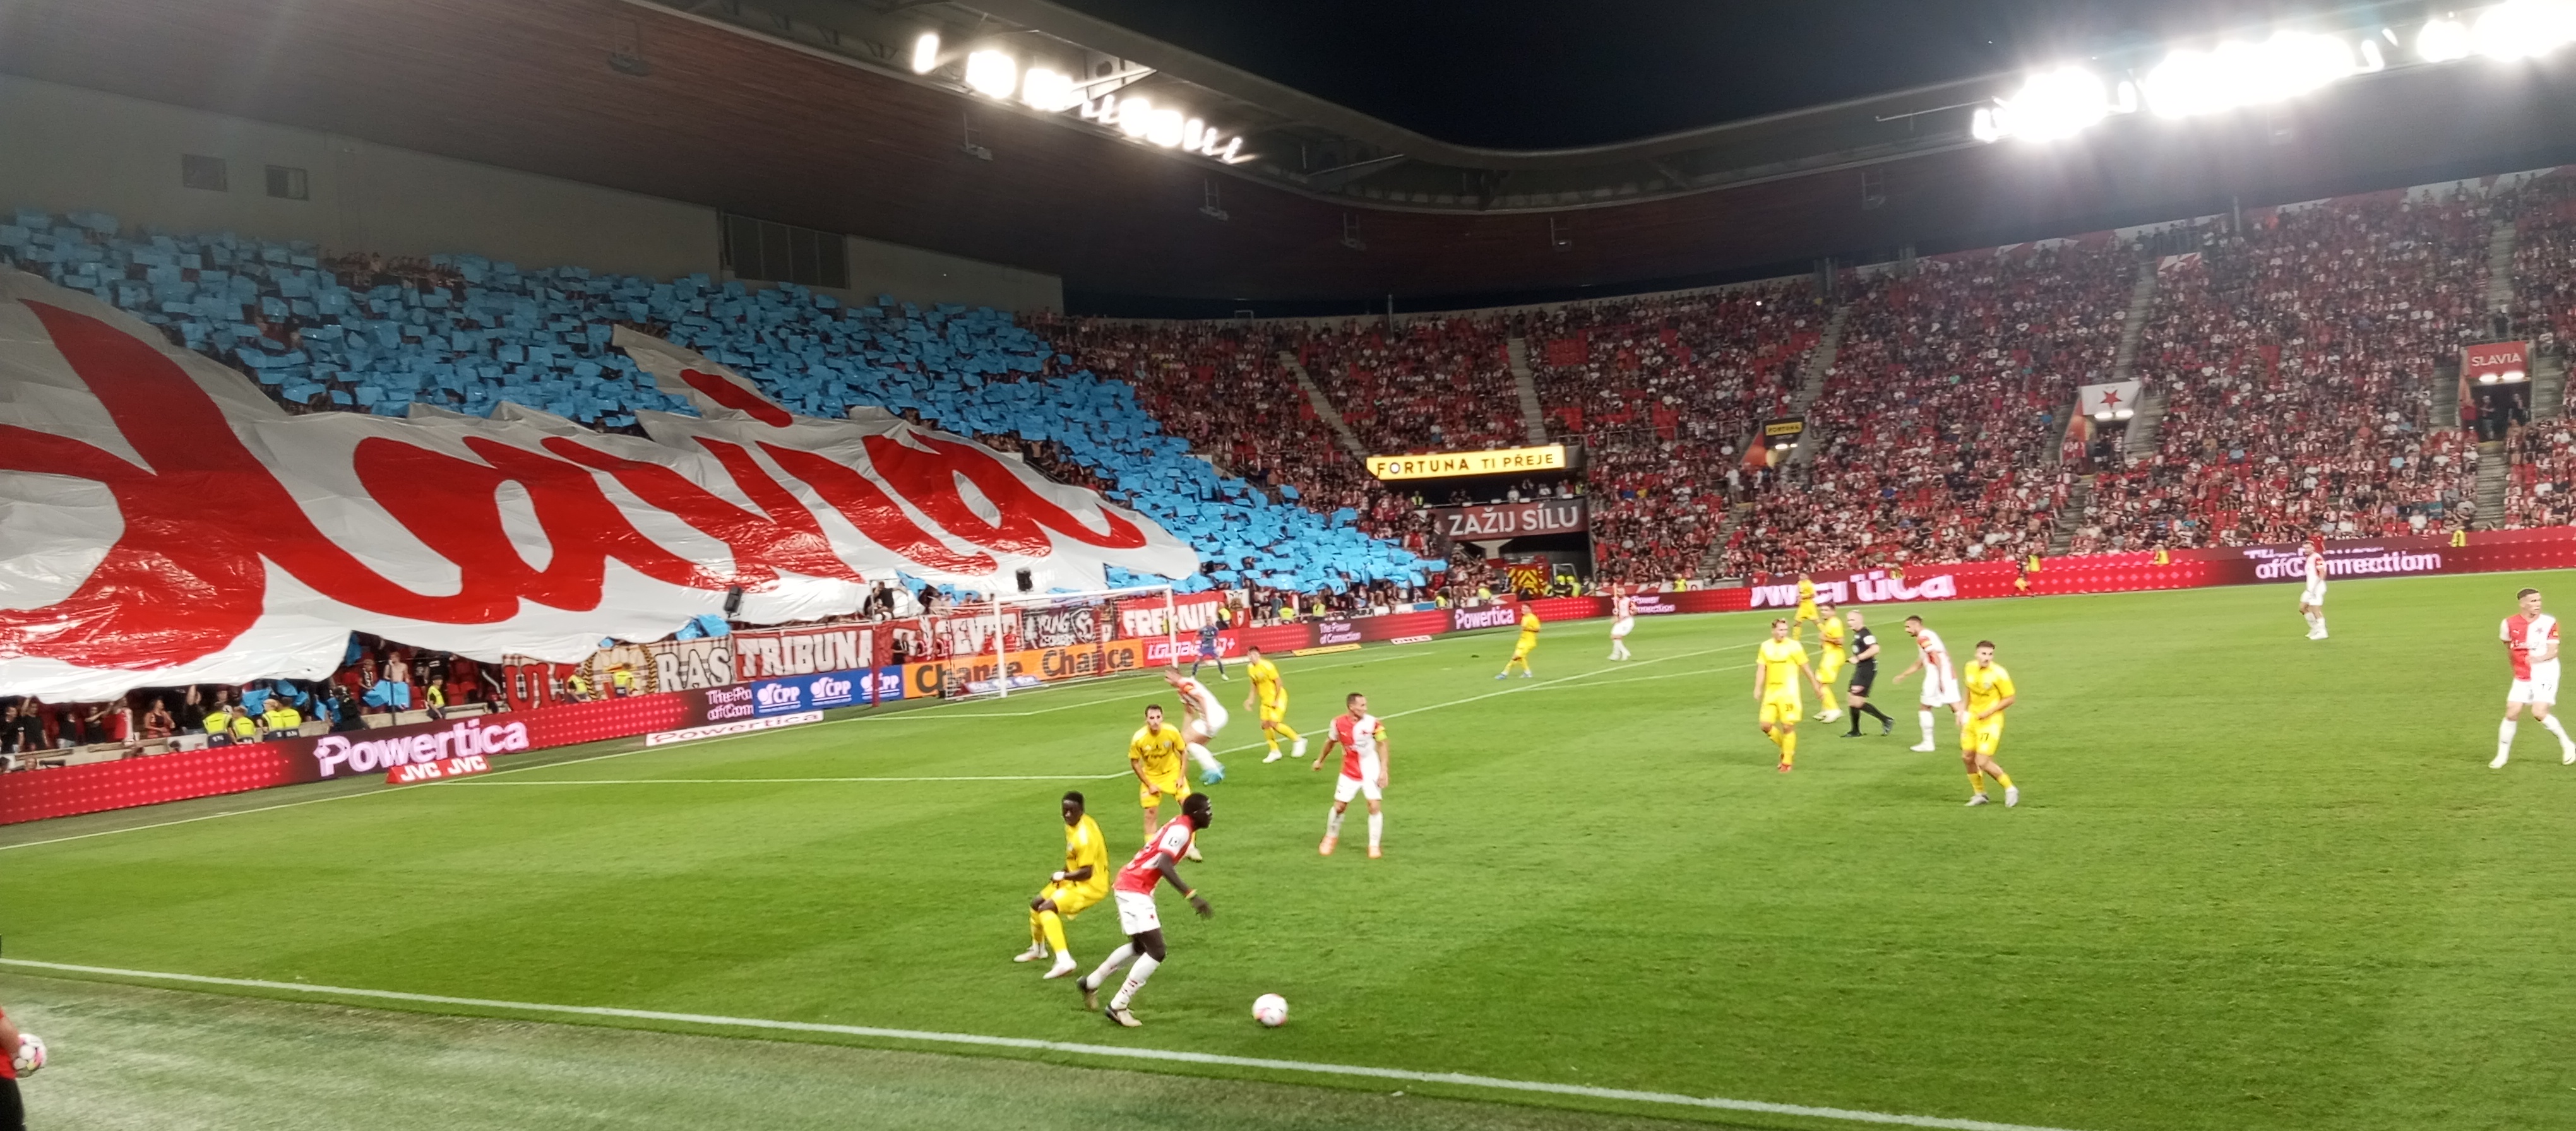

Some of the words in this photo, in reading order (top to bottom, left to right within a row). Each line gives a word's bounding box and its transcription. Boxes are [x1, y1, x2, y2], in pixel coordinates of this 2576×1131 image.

[2471, 353, 2522, 367] SLAVIA
[1377, 458, 1469, 477] FORTUNA
[1482, 458, 1496, 470] TI
[1503, 453, 1553, 468] PŘEJE
[1448, 507, 1516, 536] ZAŽIJ
[1522, 503, 1578, 531] SÍLU
[1332, 622, 1351, 632] Power
[1454, 606, 1515, 630] Powertica
[1042, 648, 1135, 677] Chance
[826, 677, 852, 697] ČPP
[916, 660, 1024, 693] Chance
[773, 684, 801, 703] ČPP
[650, 714, 820, 743] Powertica
[313, 718, 530, 777] Powertica
[400, 761, 441, 781] JVC
[447, 755, 487, 775] JVC
